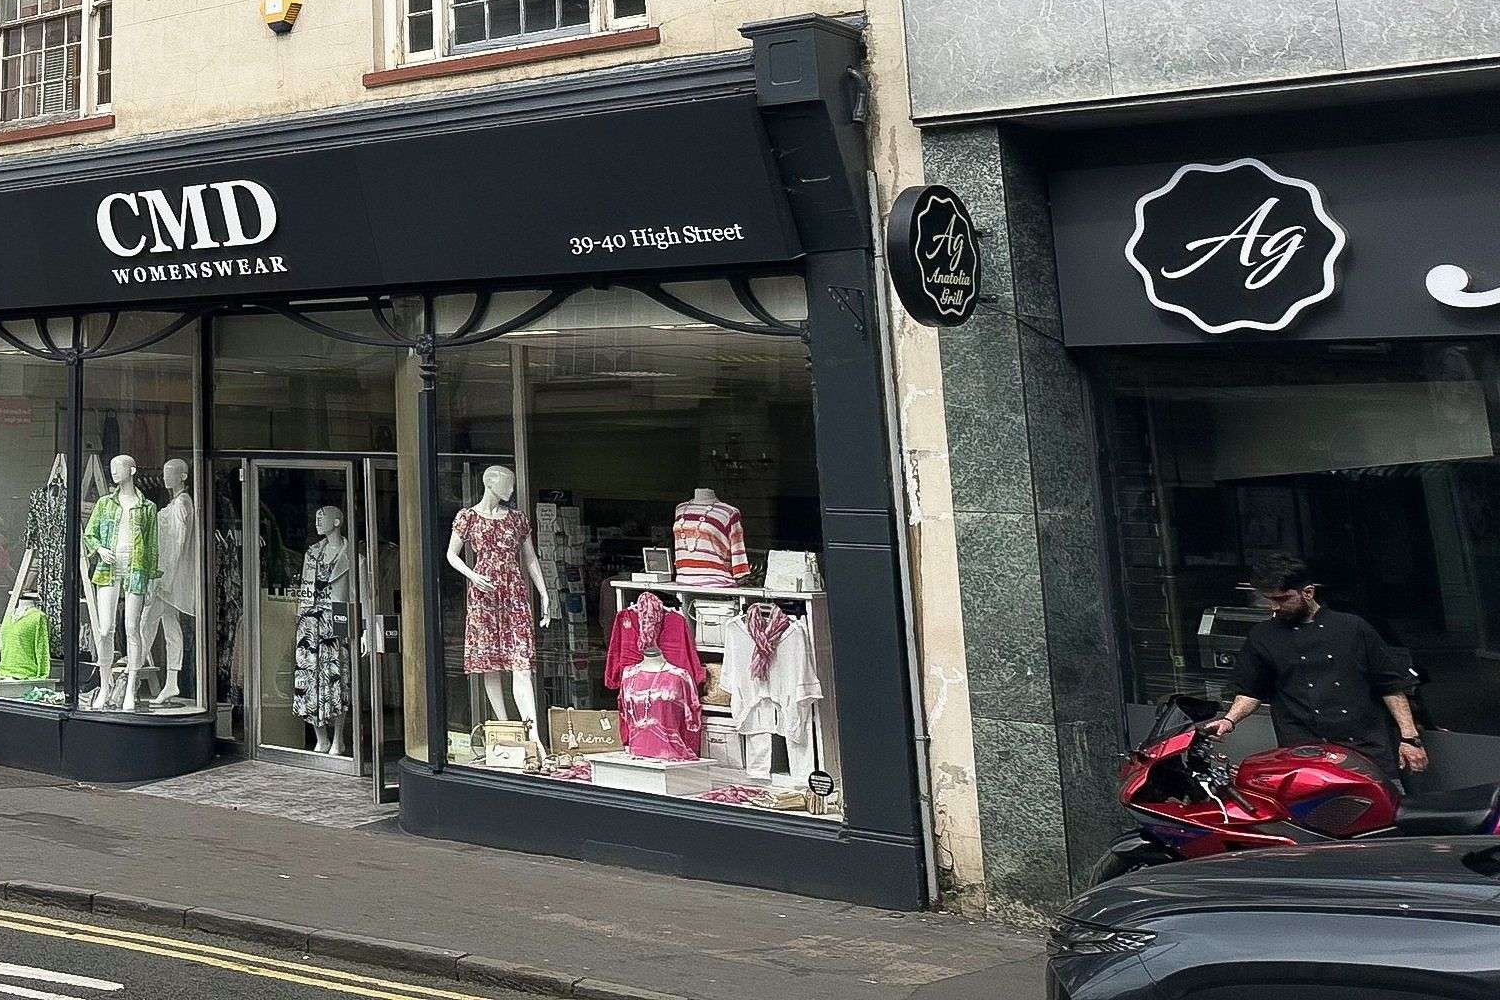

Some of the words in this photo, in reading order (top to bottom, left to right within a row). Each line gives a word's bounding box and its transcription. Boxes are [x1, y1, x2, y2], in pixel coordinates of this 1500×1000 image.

[96, 179, 277, 257] CMD
[569, 234, 626, 255] 39-40
[629, 226, 681, 250] High
[682, 223, 745, 244] Street
[925, 213, 965, 271] Ag
[1161, 197, 1307, 290] Ag
[111, 256, 288, 285] WOMENSWEAR
[926, 266, 972, 286] Anatolia
[940, 287, 964, 306] Grill
